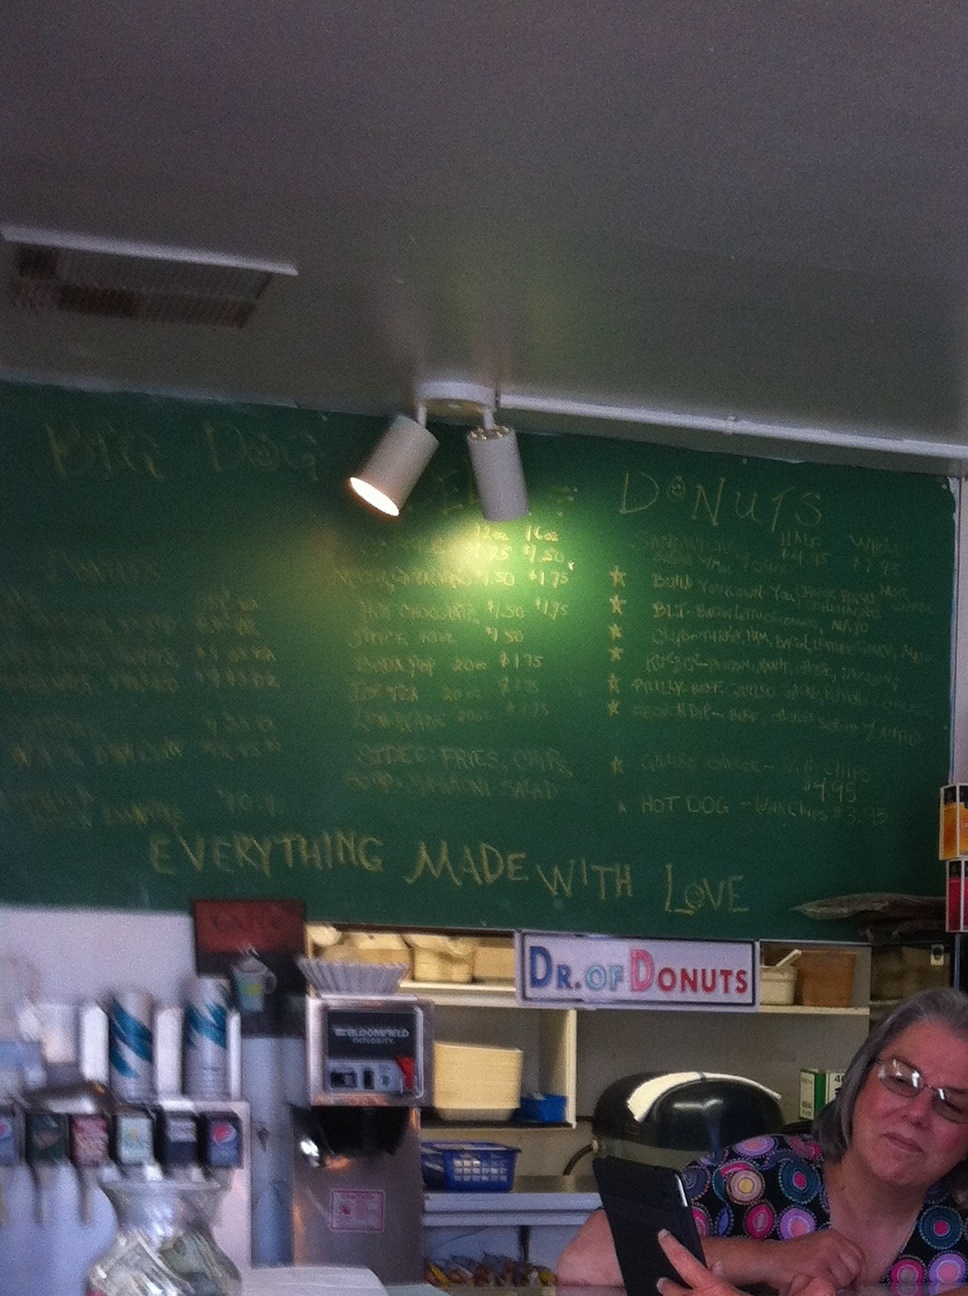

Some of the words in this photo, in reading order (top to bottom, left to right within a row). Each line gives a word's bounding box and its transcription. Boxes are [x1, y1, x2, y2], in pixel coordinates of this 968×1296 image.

[620, 472, 824, 532] DONUTS
[150, 828, 384, 877] EVERYTHING
[406, 841, 529, 887] MADE
[536, 857, 634, 900] WITH
[664, 862, 751, 917] LOVE
[530, 946, 582, 989] DR.
[585, 964, 624, 992] OF
[629, 948, 749, 995] DONUTS
